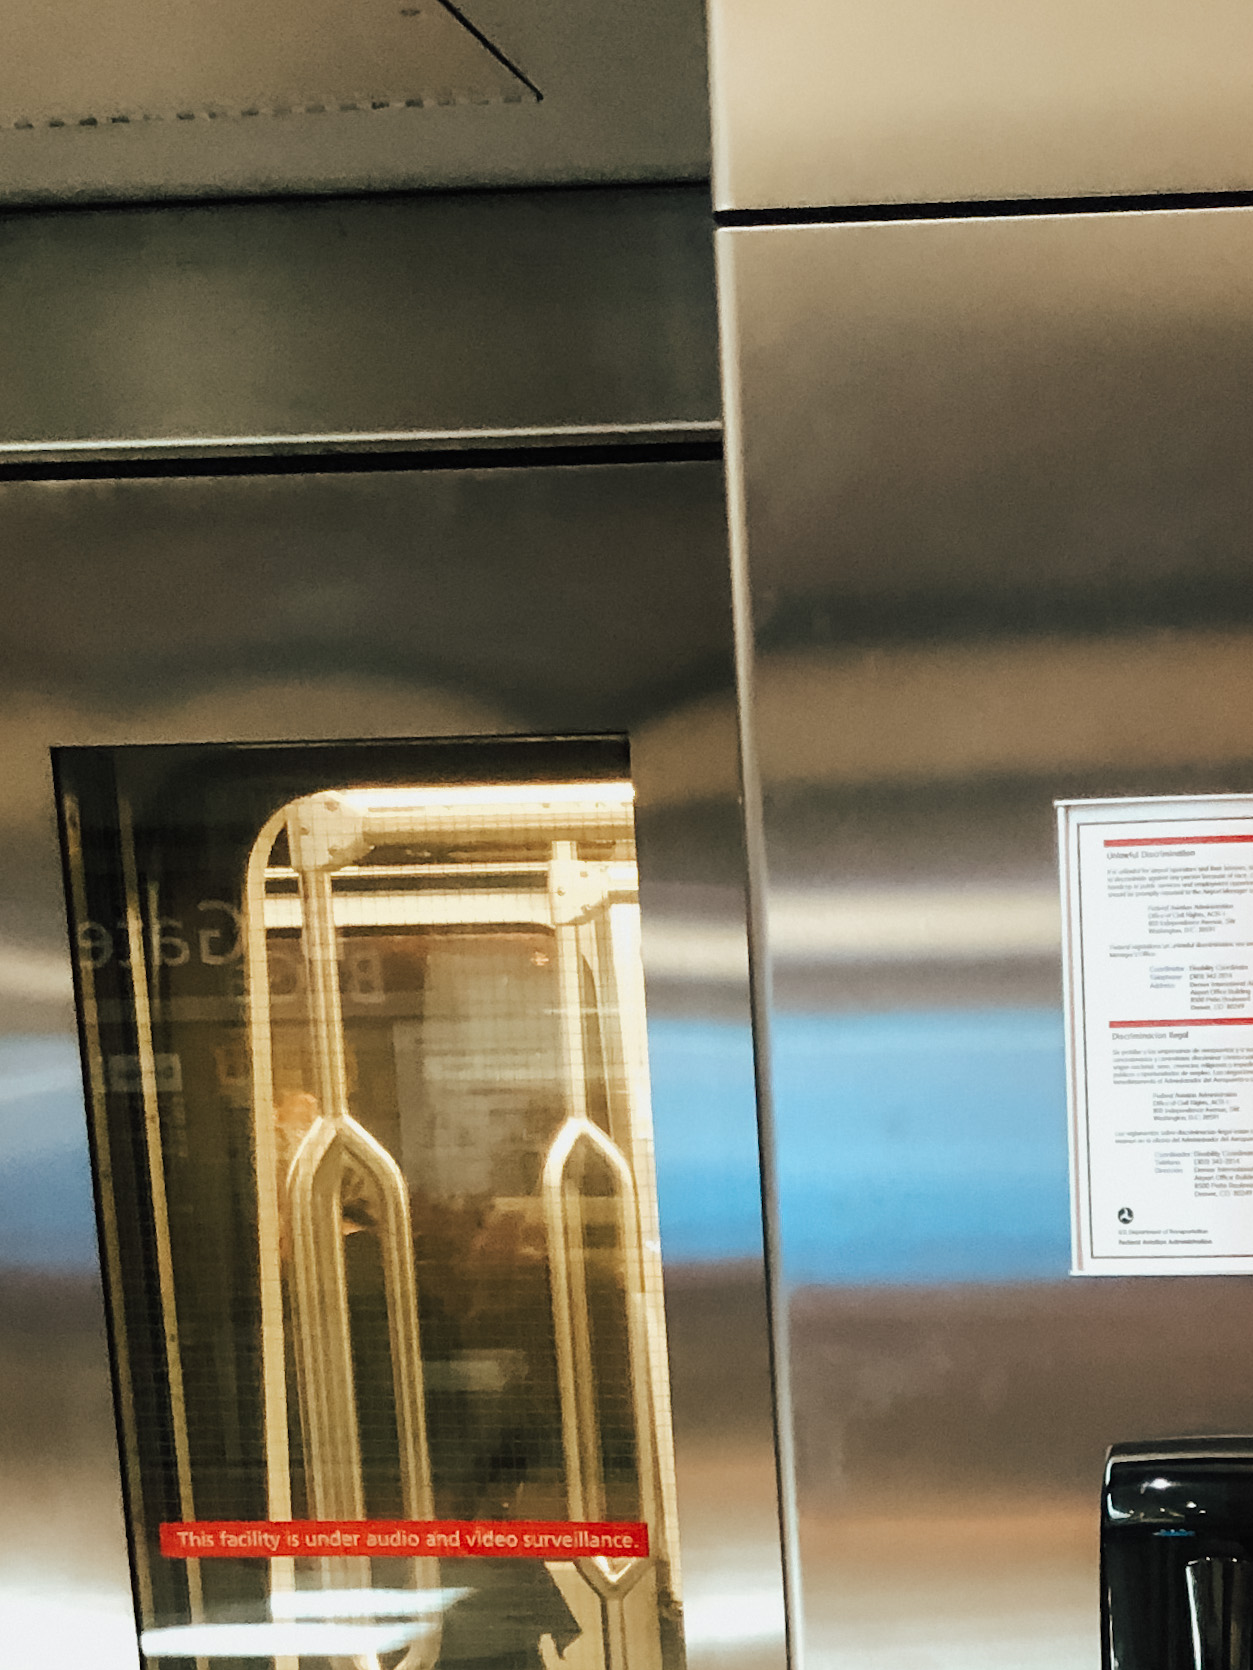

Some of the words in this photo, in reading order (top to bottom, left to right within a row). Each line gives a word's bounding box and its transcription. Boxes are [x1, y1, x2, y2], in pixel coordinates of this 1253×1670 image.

[176, 1530, 215, 1548] This
[219, 1529, 281, 1552] facility
[287, 1531, 300, 1548] is
[305, 1529, 361, 1548] under
[366, 1529, 420, 1548] audio
[425, 1530, 461, 1548] and
[465, 1529, 519, 1548] video
[523, 1530, 640, 1549] surveillance.
